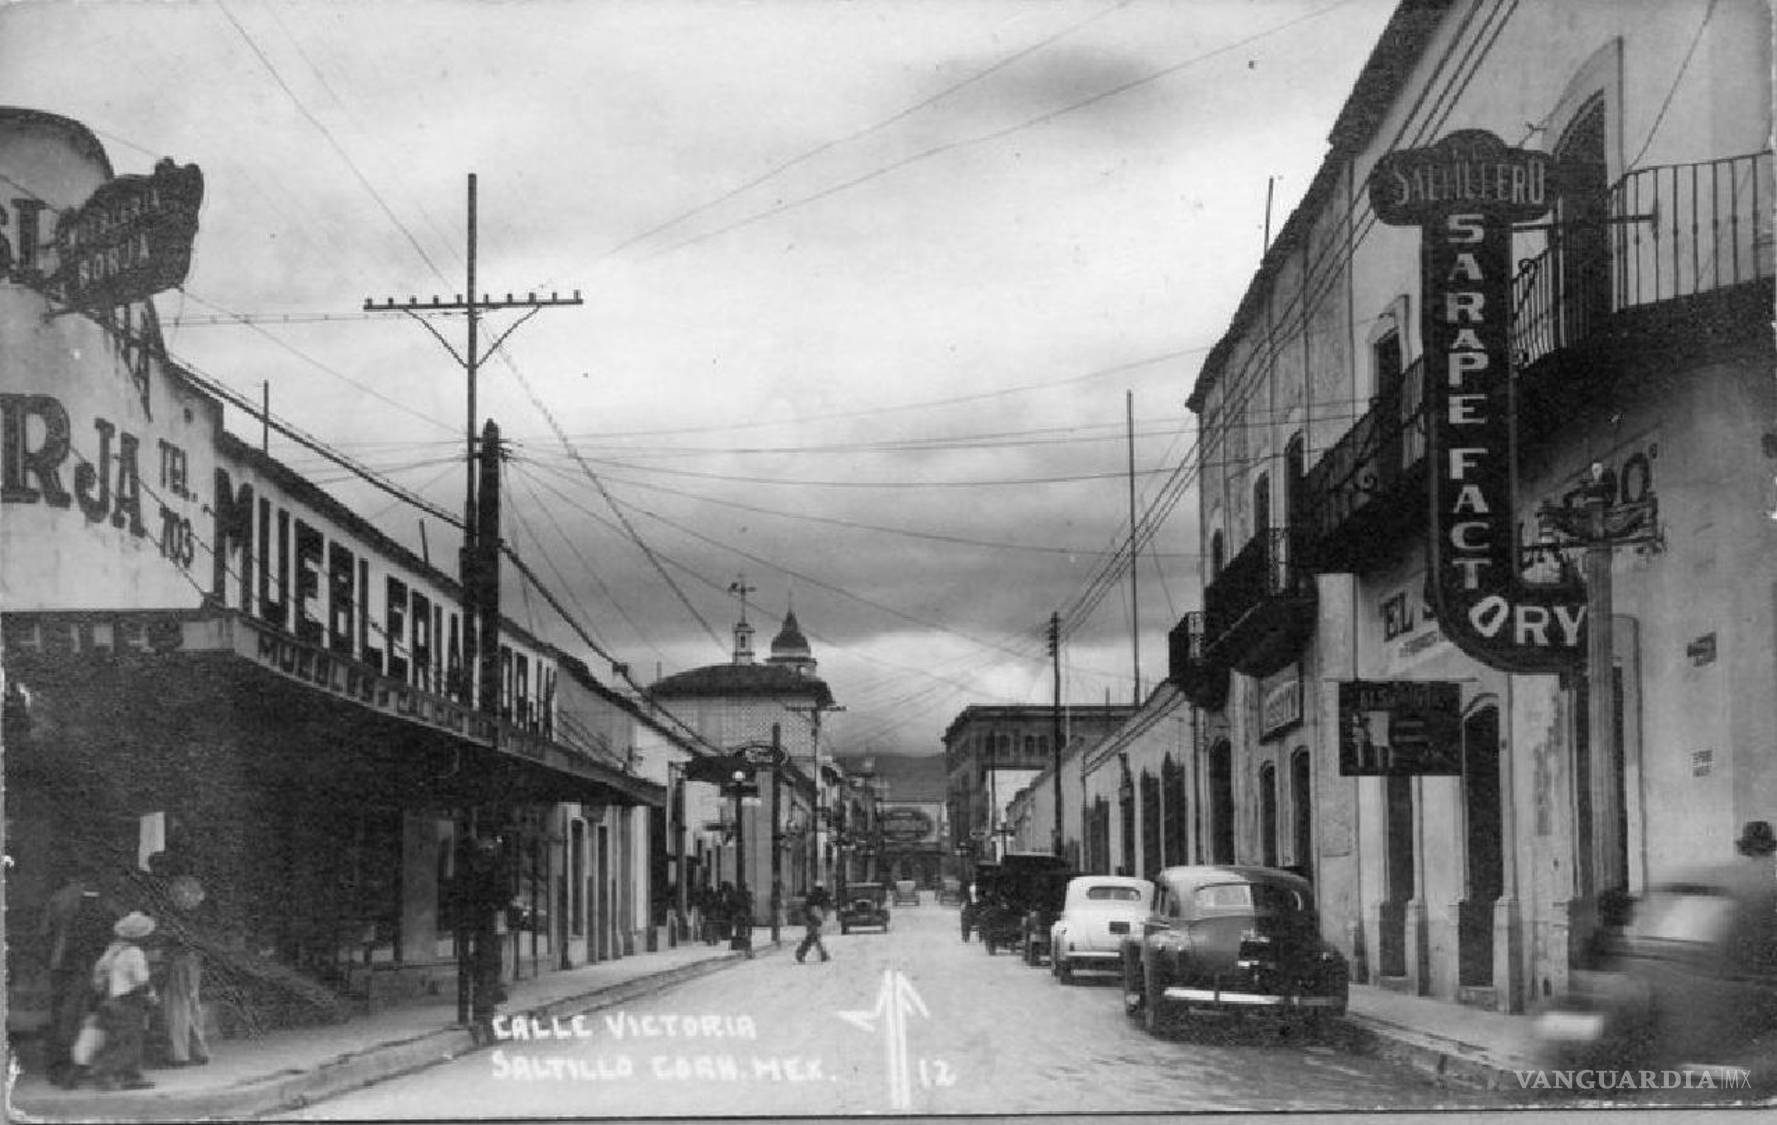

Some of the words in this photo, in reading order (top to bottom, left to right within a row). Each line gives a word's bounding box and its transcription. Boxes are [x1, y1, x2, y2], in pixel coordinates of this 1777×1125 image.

[1446, 213, 1490, 424] SARAPE
[214, 466, 468, 706] MUEBLERIA
[1449, 448, 1588, 647] FACTORY
